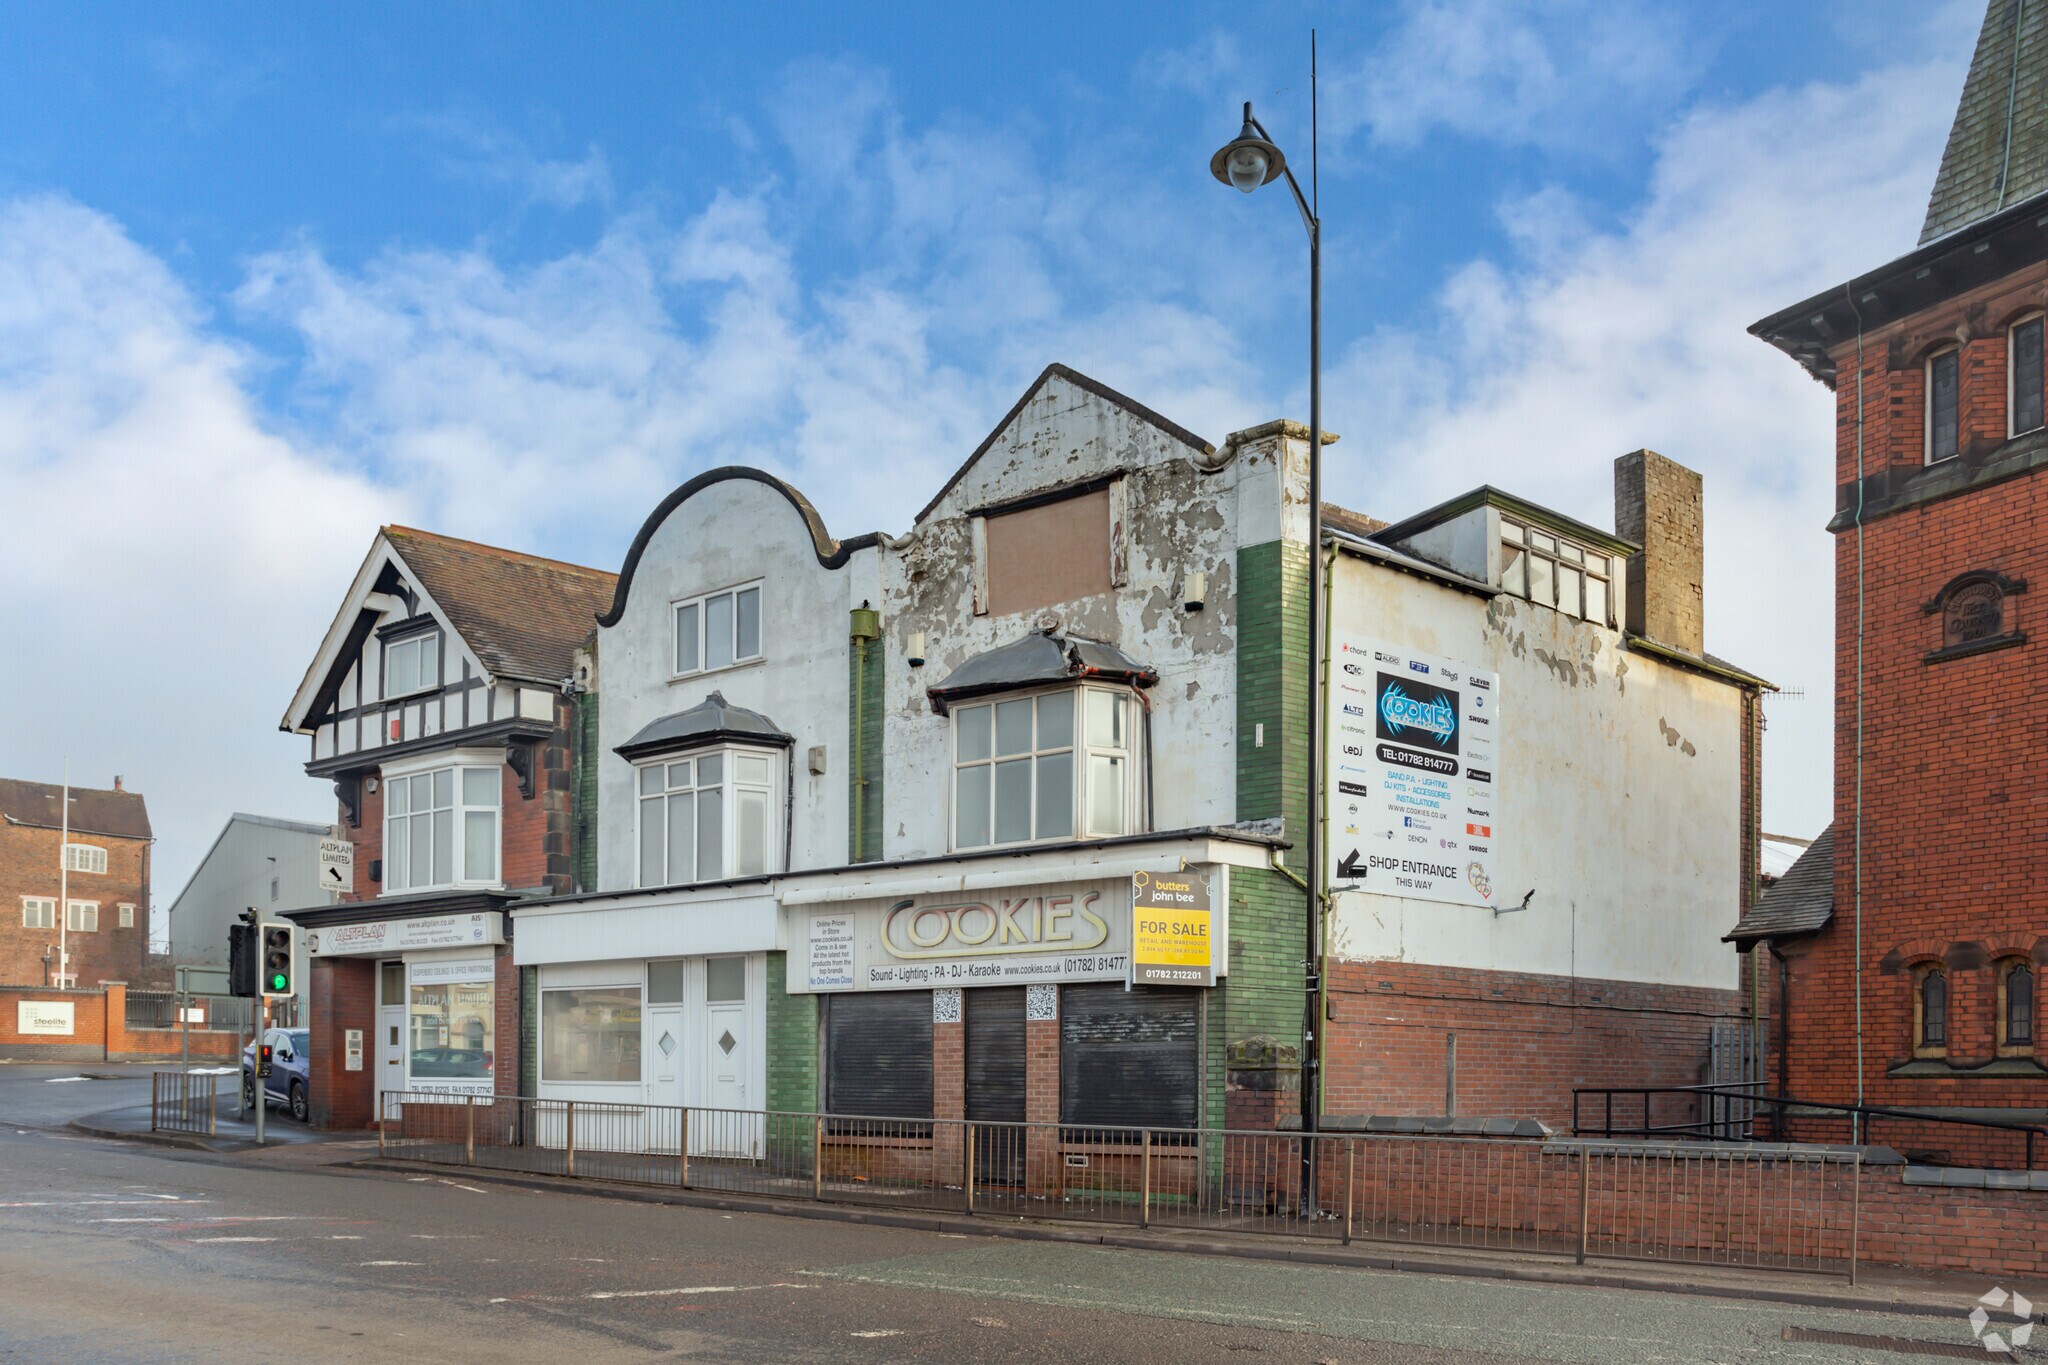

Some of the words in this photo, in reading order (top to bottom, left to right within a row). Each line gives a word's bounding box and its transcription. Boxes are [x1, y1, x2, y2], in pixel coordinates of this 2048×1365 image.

[1350, 646, 1366, 656] chord
[1382, 655, 1399, 664] AUDIO
[1470, 677, 1490, 686] CLEVER
[1382, 692, 1454, 734] COOKIES
[1382, 748, 1397, 760] TEL:
[1398, 752, 1423, 766] 01782
[1424, 758, 1453, 771] 814777
[1388, 771, 1404, 780] BAND
[1422, 778, 1448, 789] LIGHTING
[1384, 781, 1392, 789] DJ
[1394, 783, 1406, 791] KITS
[1412, 787, 1451, 800] ACCESSORIES
[1396, 794, 1440, 808] INSTALLATIONS
[1388, 804, 1447, 819] WWW.COOKIES.CO.UK
[1468, 807, 1490, 817] Numark
[1408, 834, 1427, 843] DENON
[1447, 841, 1457, 849] qtx
[321, 842, 352, 854] ALTPLAN
[322, 853, 350, 864] LIMITED
[1369, 855, 1399, 870] SHOP
[1402, 860, 1457, 878] ENTRANCE
[1156, 880, 1190, 891] butters
[1395, 877, 1412, 888] THIS
[1414, 880, 1432, 890] WAY
[1152, 891, 1173, 902] john
[1176, 892, 1194, 902] bee
[881, 891, 1108, 959] COOKIES
[1140, 921, 1167, 934] FOR
[1172, 923, 1206, 936] SALE
[336, 924, 386, 942] ALTPLAN
[455, 966, 467, 974] OFFICE
[468, 965, 492, 973] PARTITIONING
[871, 969, 892, 981] Sound
[900, 968, 928, 982] Lighting
[935, 966, 945, 978] PA
[952, 965, 962, 977] DJ
[969, 963, 1000, 976] Karaoke
[1004, 963, 1060, 975] www.cookies.co.uk
[1065, 957, 1095, 974] (01782)
[1146, 970, 1170, 978] 01782
[1173, 971, 1201, 979] 212201
[418, 993, 454, 1006] ALTPLAN
[458, 993, 489, 1006] LIMITED
